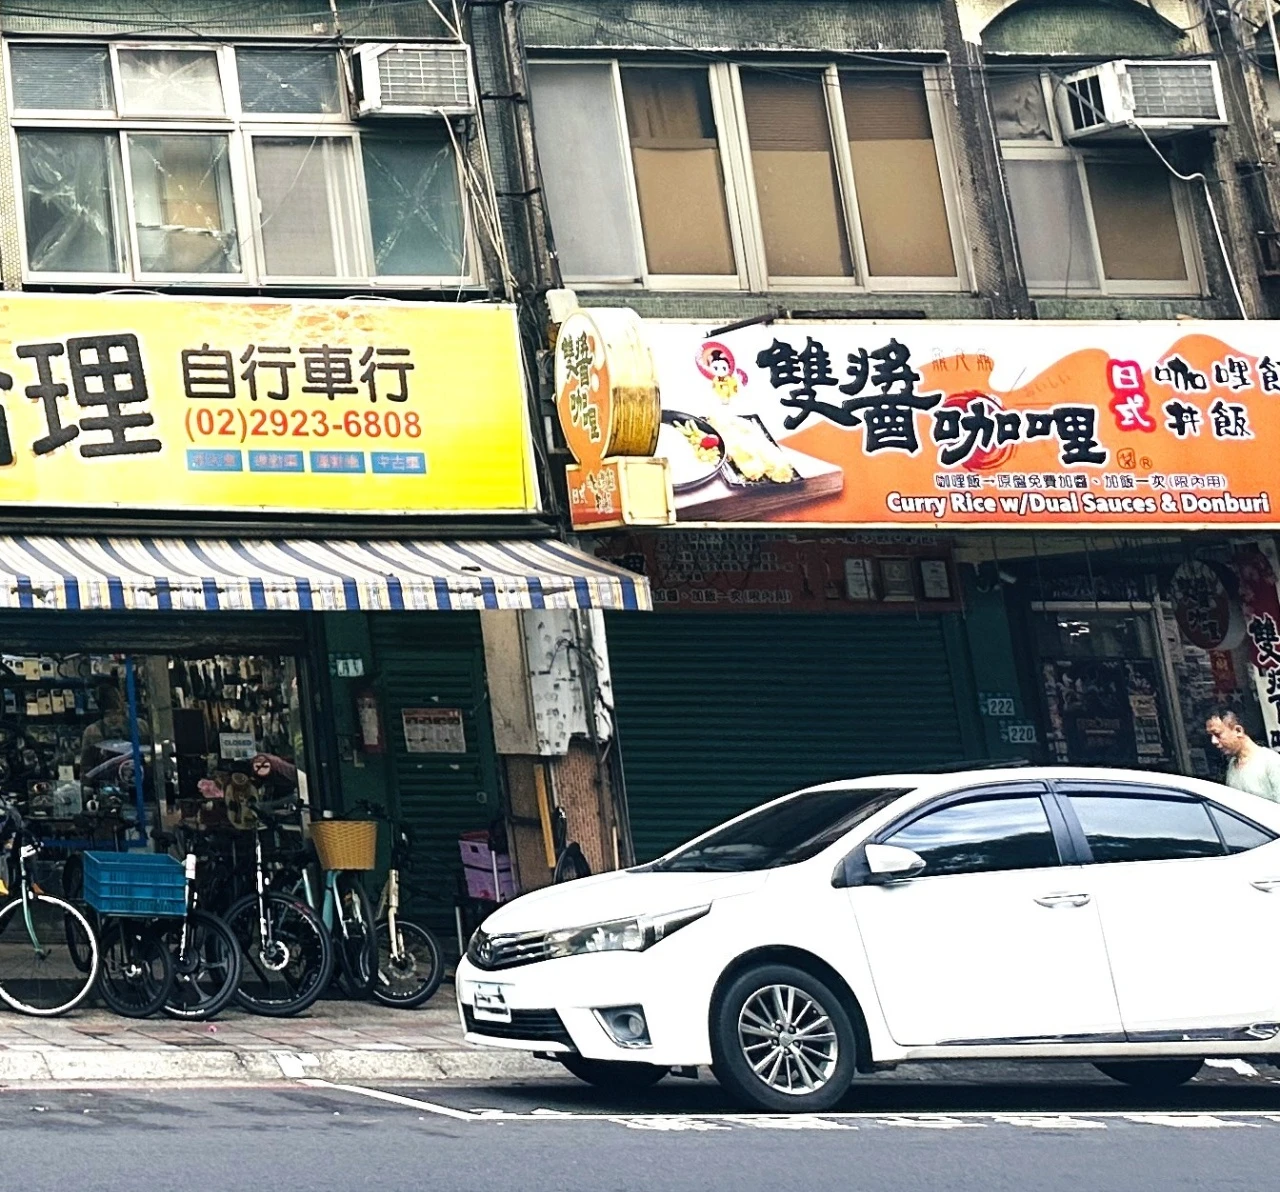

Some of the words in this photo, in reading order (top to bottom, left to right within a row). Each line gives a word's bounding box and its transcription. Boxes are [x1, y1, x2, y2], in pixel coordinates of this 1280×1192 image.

[181, 342, 415, 403] 自行車行
[756, 336, 1107, 466] 雙醬咖哩
[1112, 363, 1151, 429] 日式
[185, 407, 423, 443] (02)2923-6808
[1165, 401, 1252, 438] 丼飯
[886, 493, 946, 517] Curry
[951, 492, 997, 513] Rice
[1000, 493, 1079, 516] w/Dual
[1083, 493, 1158, 514] Sauces
[1159, 493, 1178, 513] &
[1180, 492, 1271, 514] Donburi
[990, 700, 1013, 714] 222
[1011, 727, 1035, 742] 220
